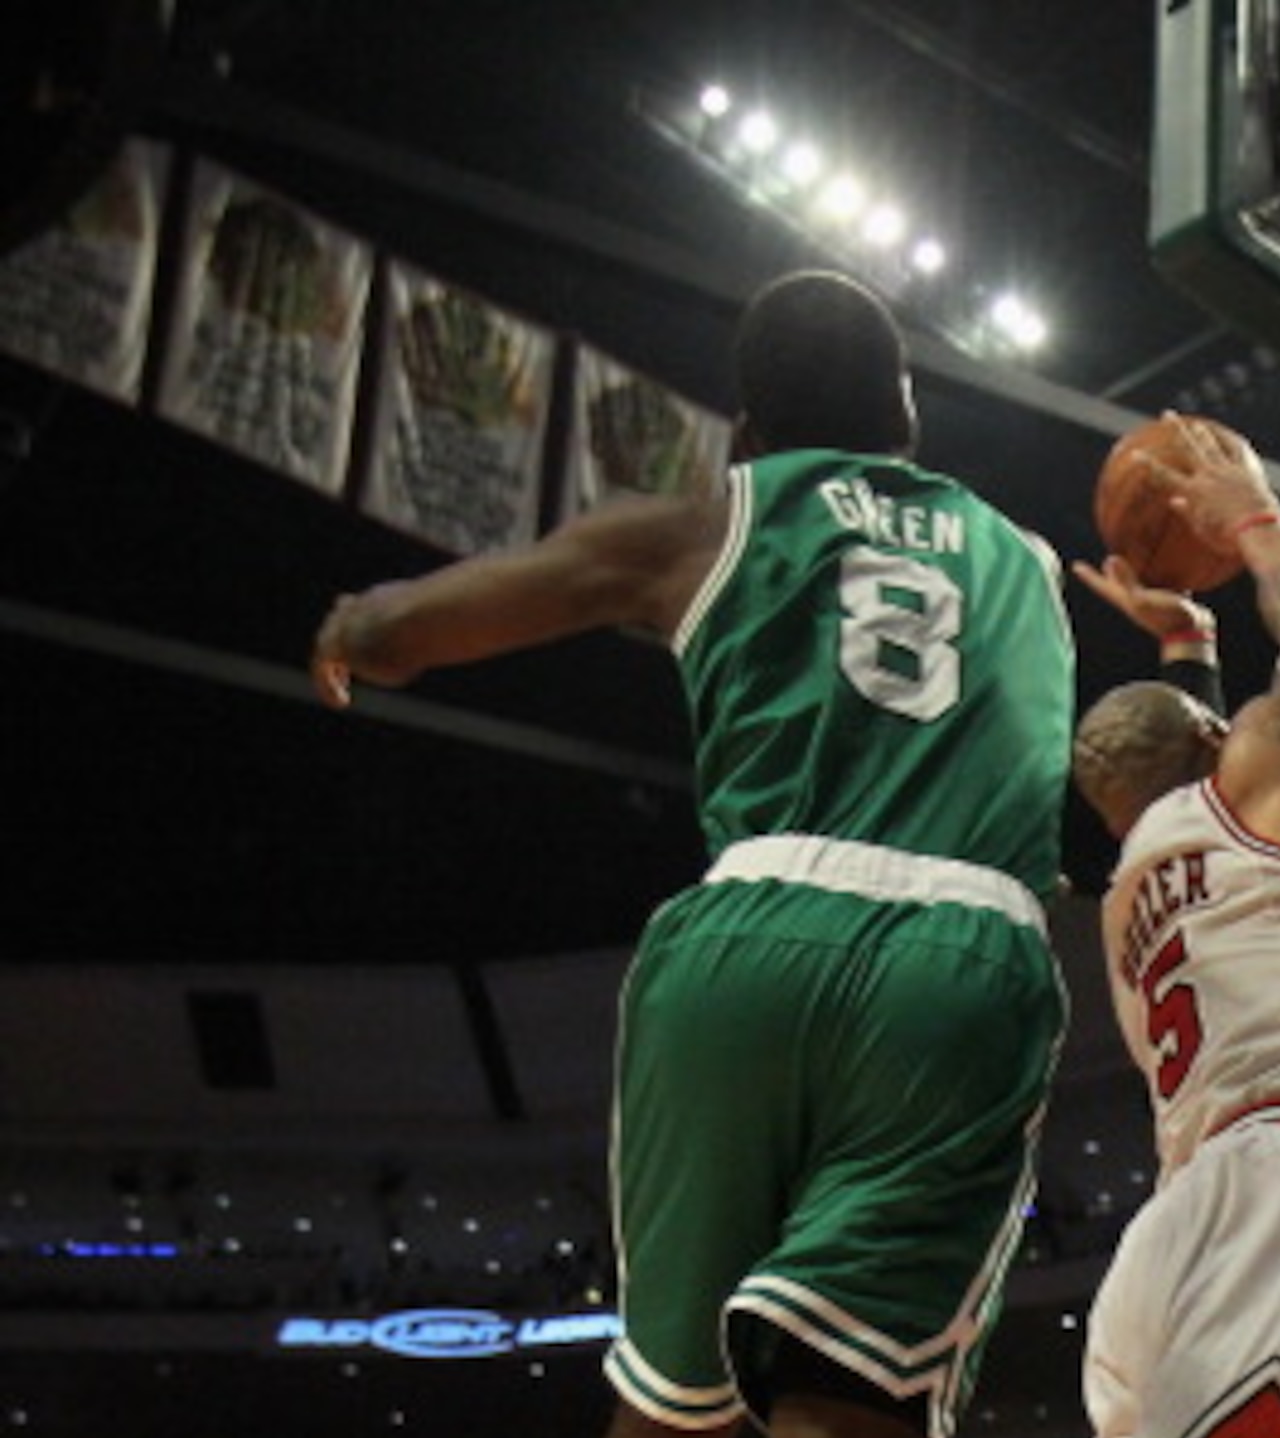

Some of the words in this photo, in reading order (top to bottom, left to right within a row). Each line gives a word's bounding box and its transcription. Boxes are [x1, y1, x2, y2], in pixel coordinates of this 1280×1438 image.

[819, 477, 964, 554] GREEN
[839, 545, 963, 722] 8
[1143, 926, 1204, 1100] 5
